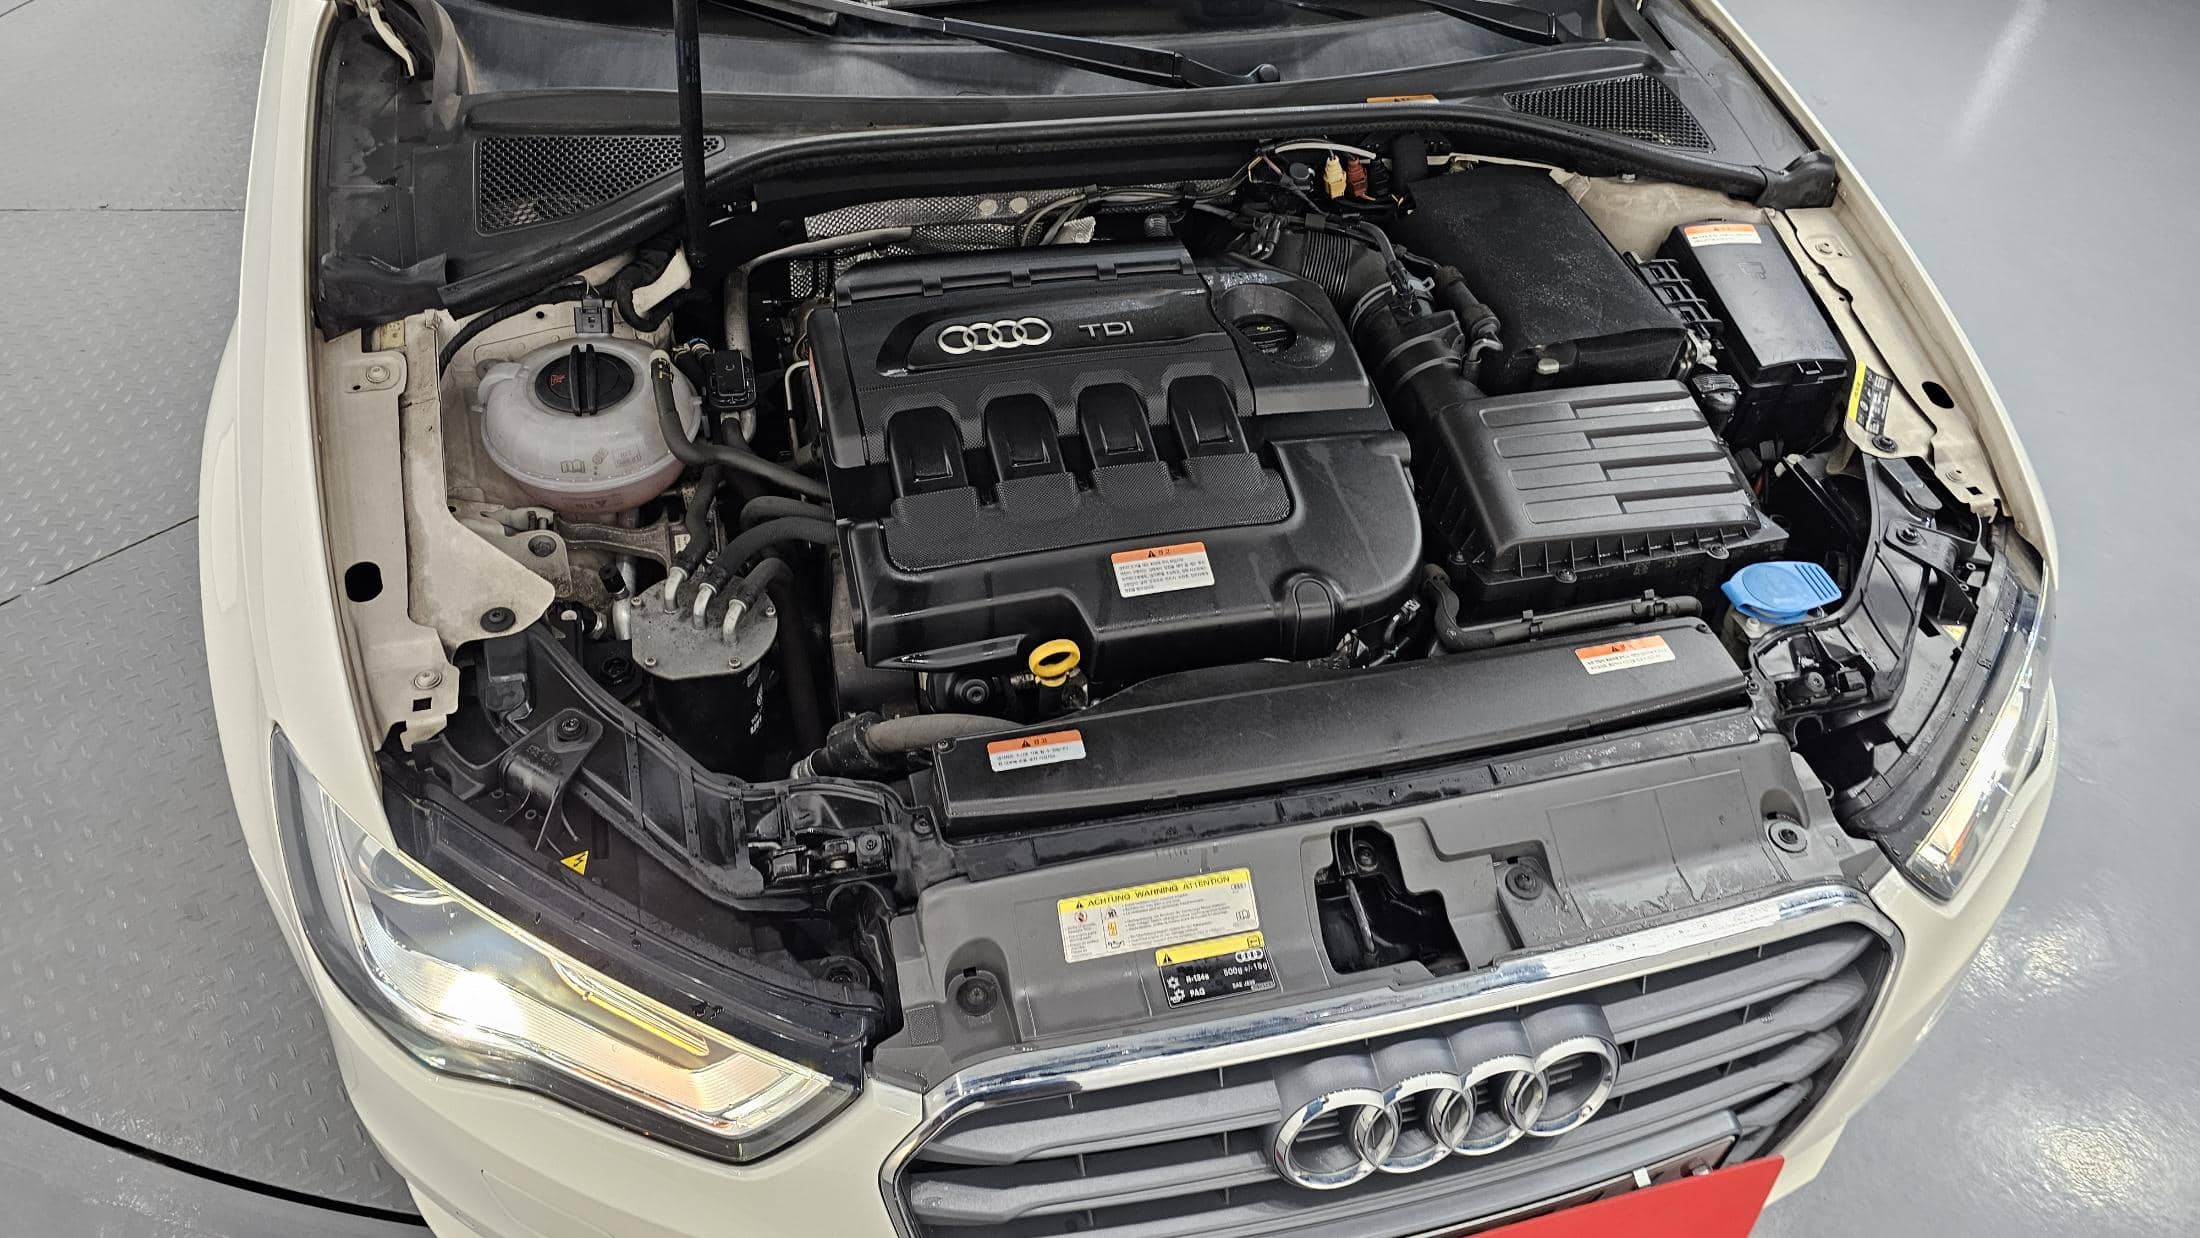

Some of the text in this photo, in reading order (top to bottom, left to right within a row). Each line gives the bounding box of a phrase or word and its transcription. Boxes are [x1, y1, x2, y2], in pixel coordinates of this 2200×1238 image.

[1079, 320, 1133, 337] TDI
[1088, 894, 1131, 907] ACHTUNG
[1135, 884, 1179, 898] WARNING
[1183, 876, 1230, 891] ATTENTION
